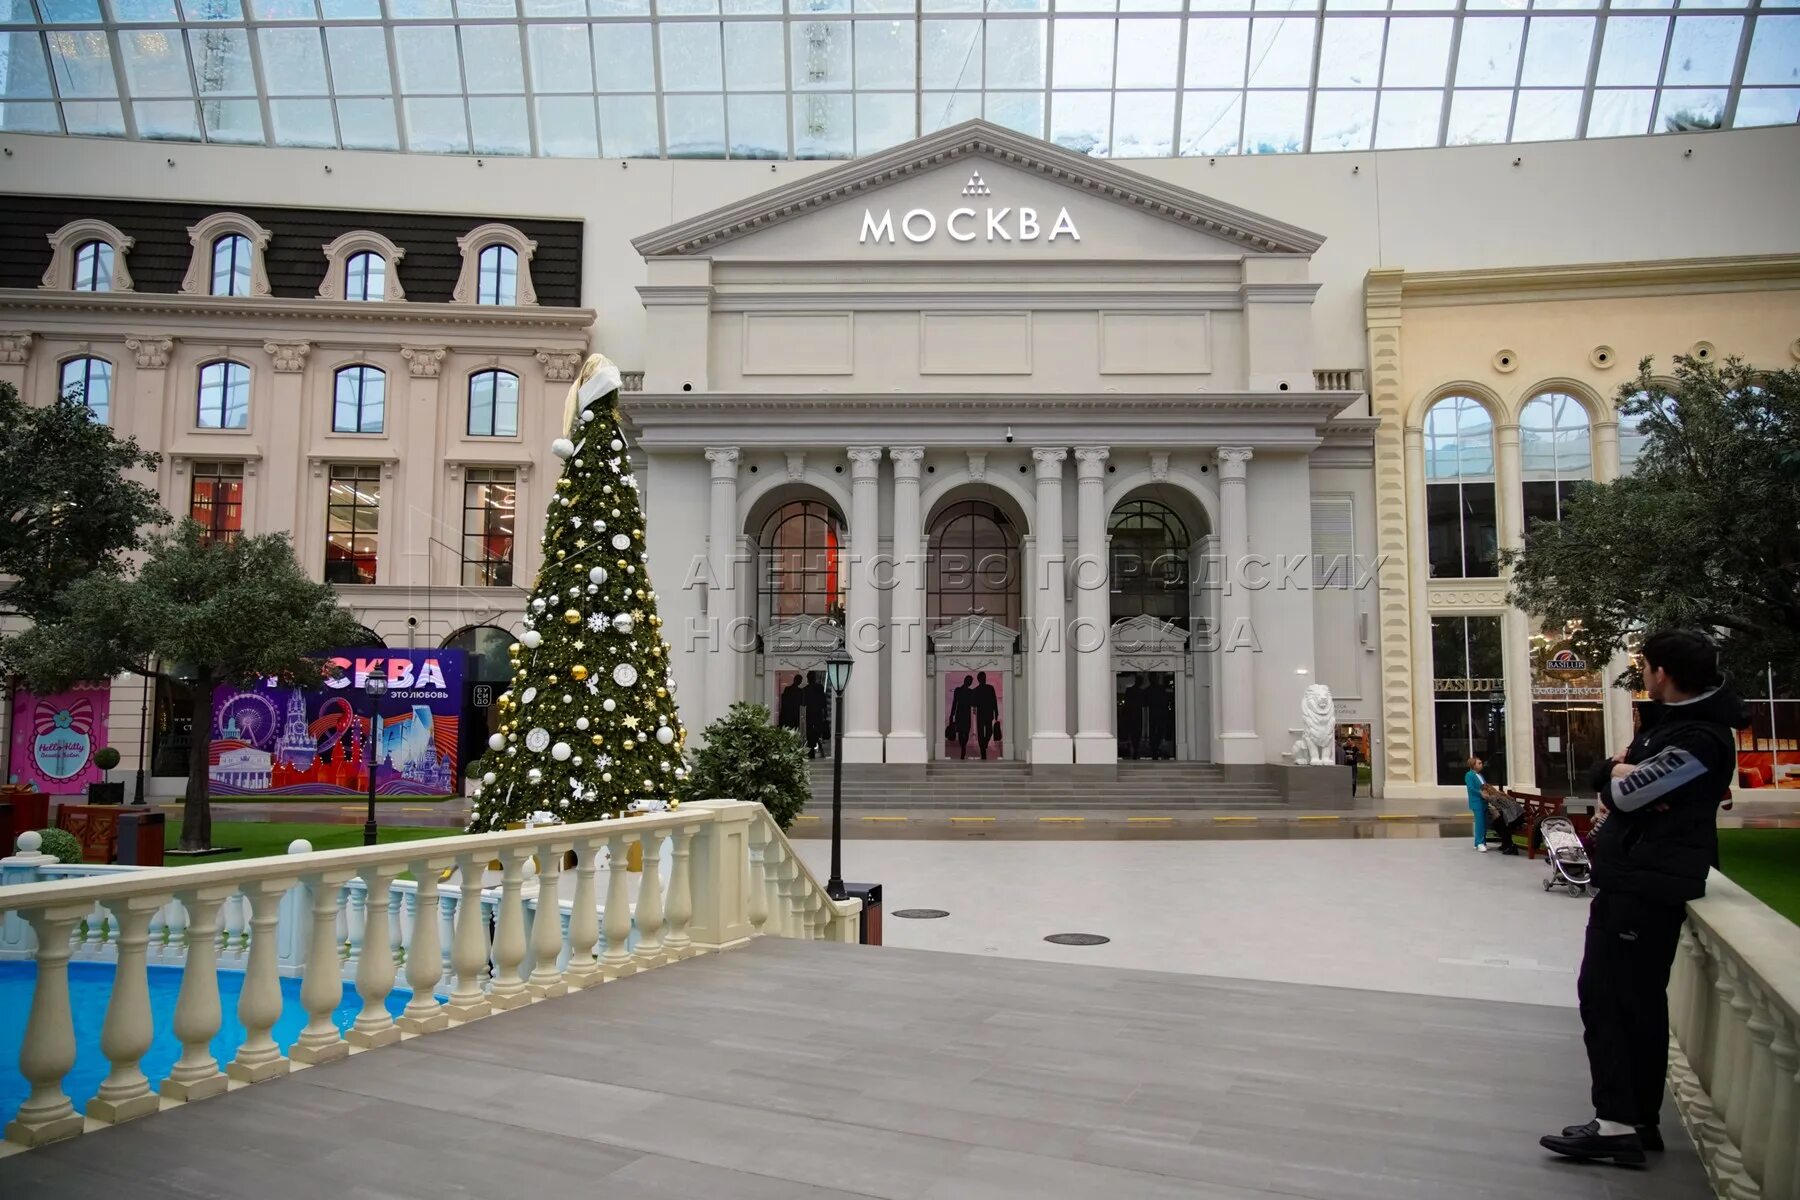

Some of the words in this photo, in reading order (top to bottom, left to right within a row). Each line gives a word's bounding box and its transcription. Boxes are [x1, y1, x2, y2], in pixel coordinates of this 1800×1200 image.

[859, 206, 1081, 243] МОСКВА
[39, 744, 61, 752] Hello
[64, 742, 84, 752] Kitty
